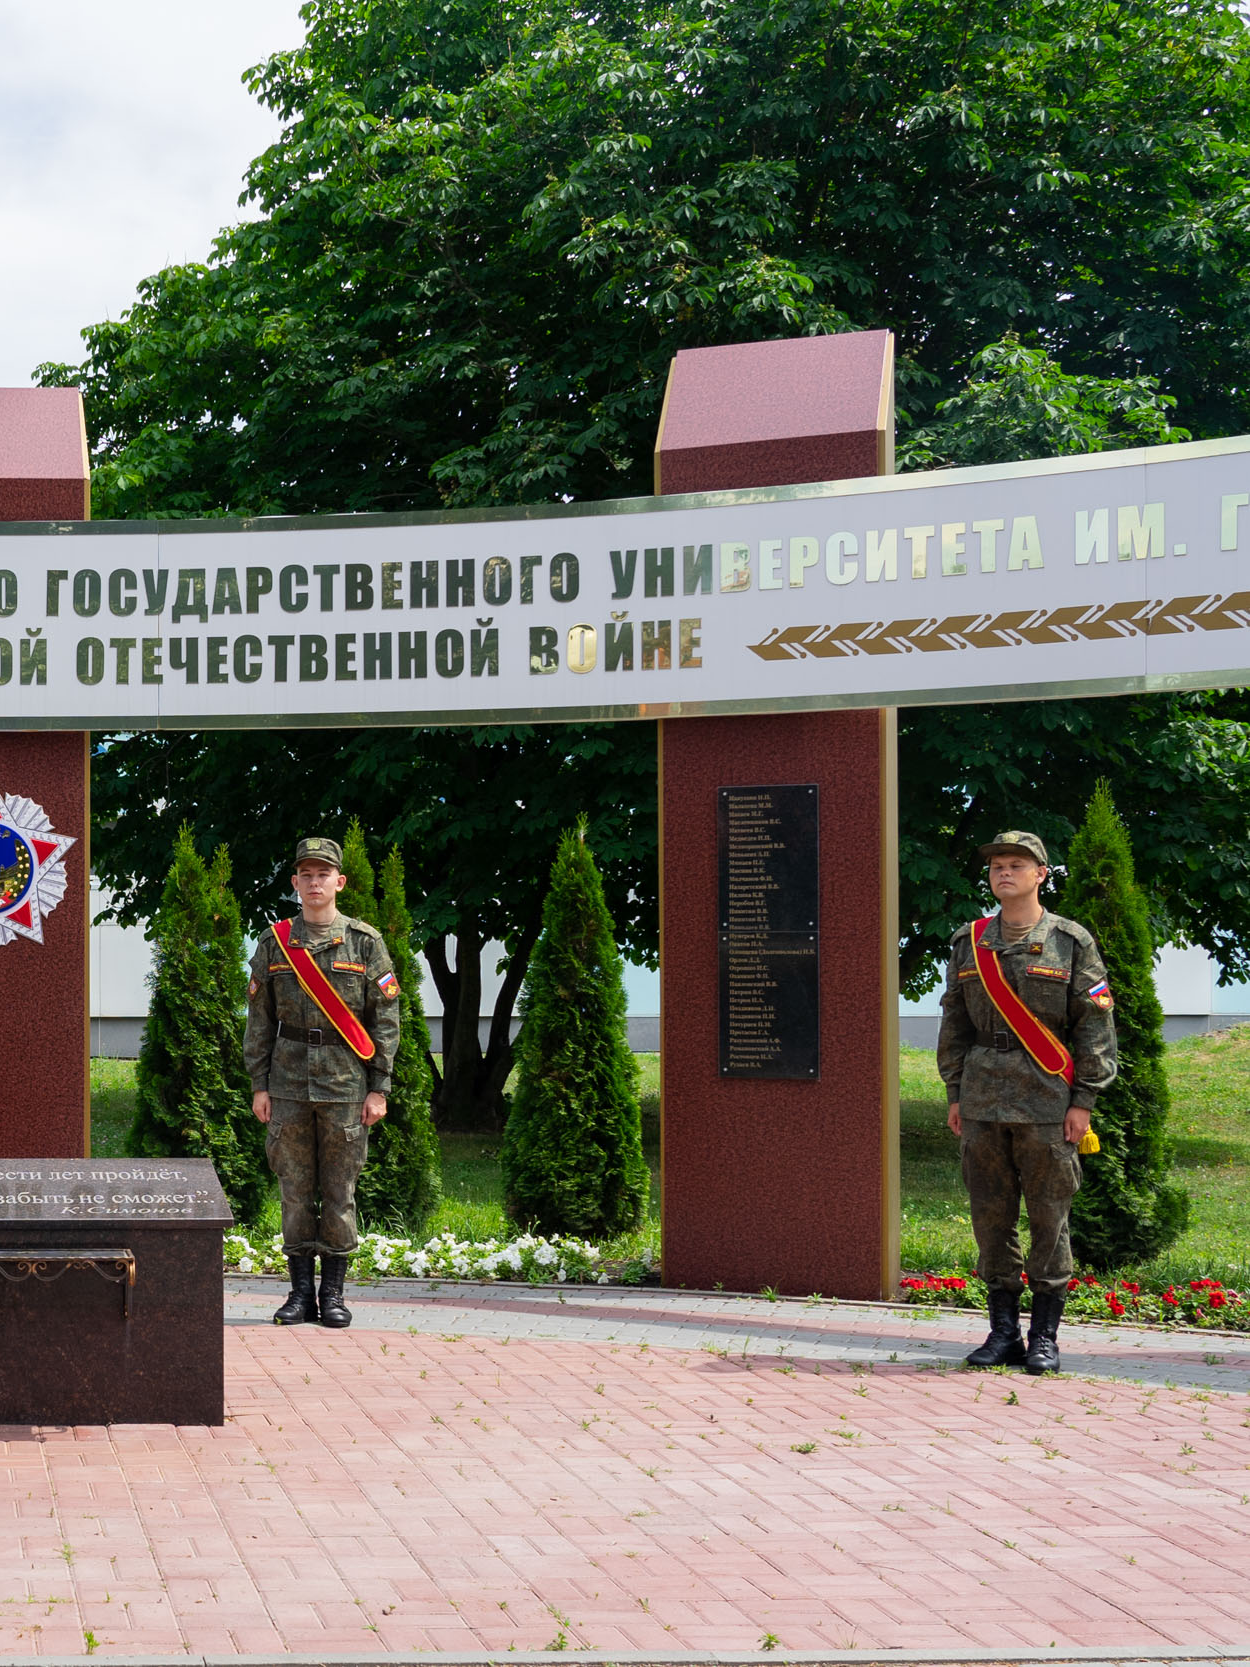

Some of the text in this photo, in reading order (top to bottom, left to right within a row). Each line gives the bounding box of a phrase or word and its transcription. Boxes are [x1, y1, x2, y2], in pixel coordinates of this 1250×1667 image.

[46, 552, 581, 624] ГОСУДАРСТВЕННОГО
[610, 515, 1046, 600] УНИВЕРСИТЕТА
[1075, 502, 1187, 565] ИМ.
[75, 618, 500, 686] ОТЕЧЕСТВЕННОЙ
[529, 611, 703, 676] ВОЙНЕ
[48, 1171, 84, 1181] лет
[91, 1168, 188, 1183] пройдёт,
[79, 1195, 105, 1204] не
